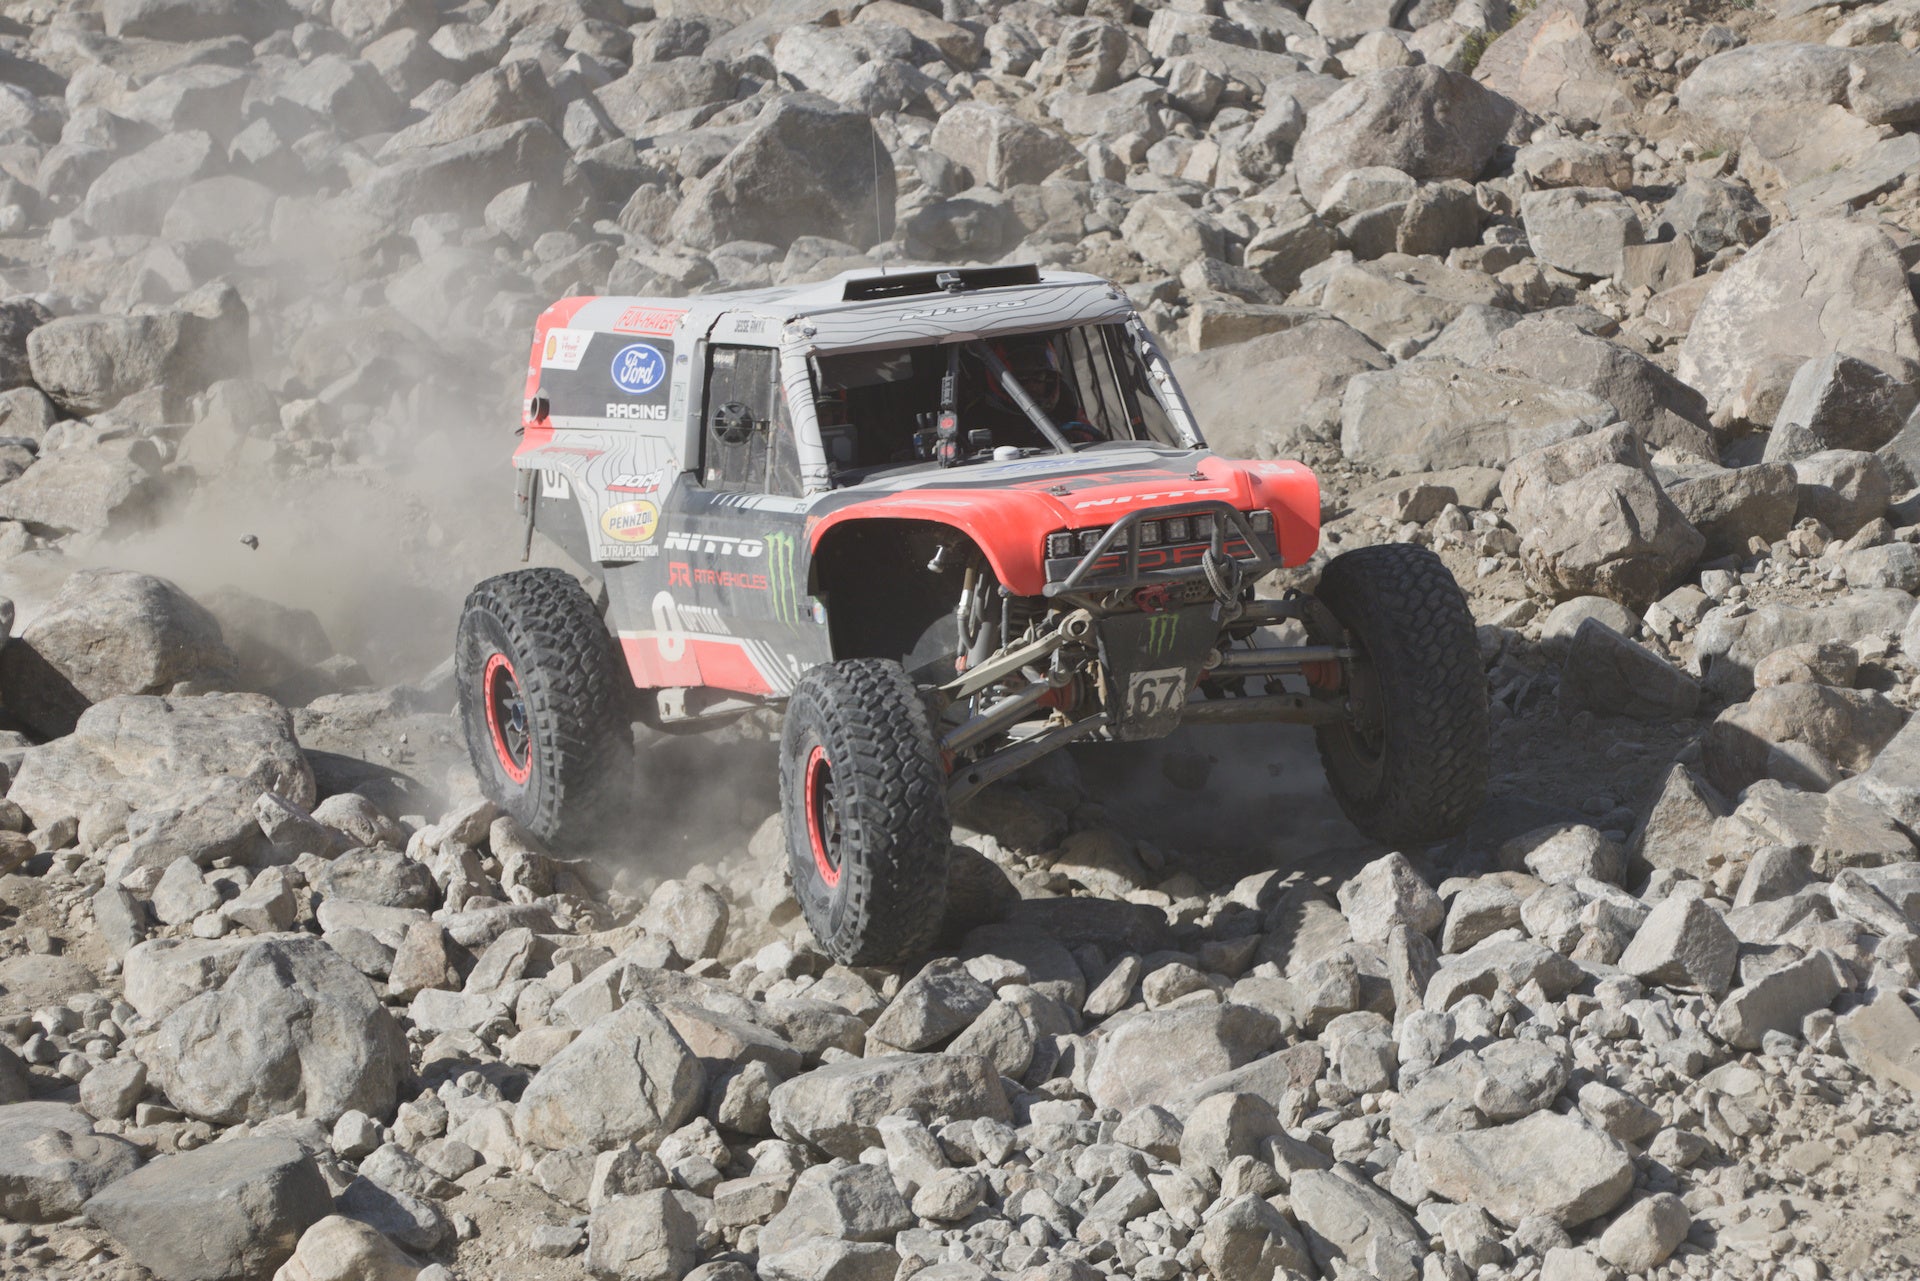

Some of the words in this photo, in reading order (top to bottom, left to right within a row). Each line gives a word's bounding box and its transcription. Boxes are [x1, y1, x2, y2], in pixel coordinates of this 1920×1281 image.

[620, 349, 656, 385] Ford
[606, 403, 667, 420] RACING
[1074, 487, 1231, 509] NITTO
[663, 531, 763, 558] NITTO
[693, 568, 715, 585] RTR
[716, 571, 768, 590] VEHICLES
[1133, 674, 1182, 717] 67
